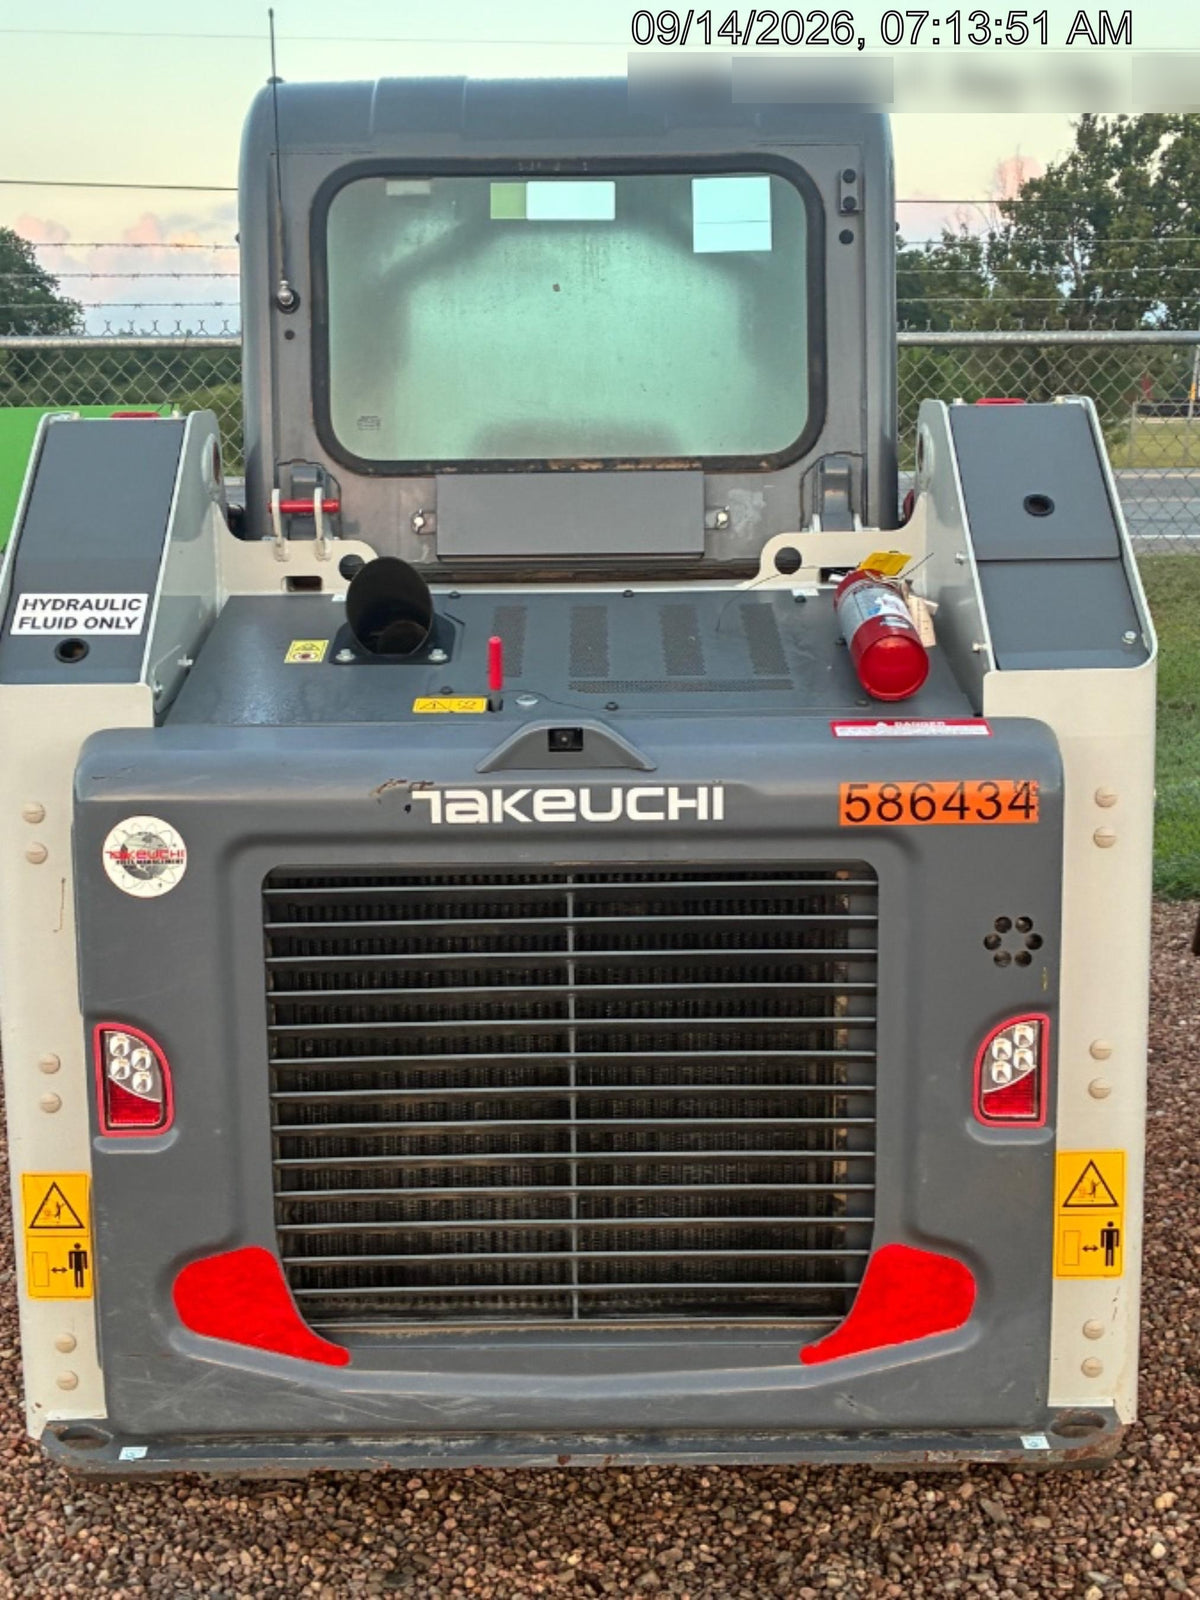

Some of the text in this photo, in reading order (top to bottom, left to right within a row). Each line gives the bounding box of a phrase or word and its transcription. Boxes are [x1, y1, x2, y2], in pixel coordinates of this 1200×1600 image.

[22, 598, 142, 611] HYDRAULIC
[18, 616, 139, 630] FLUID ONLY
[845, 781, 1036, 822] 586434
